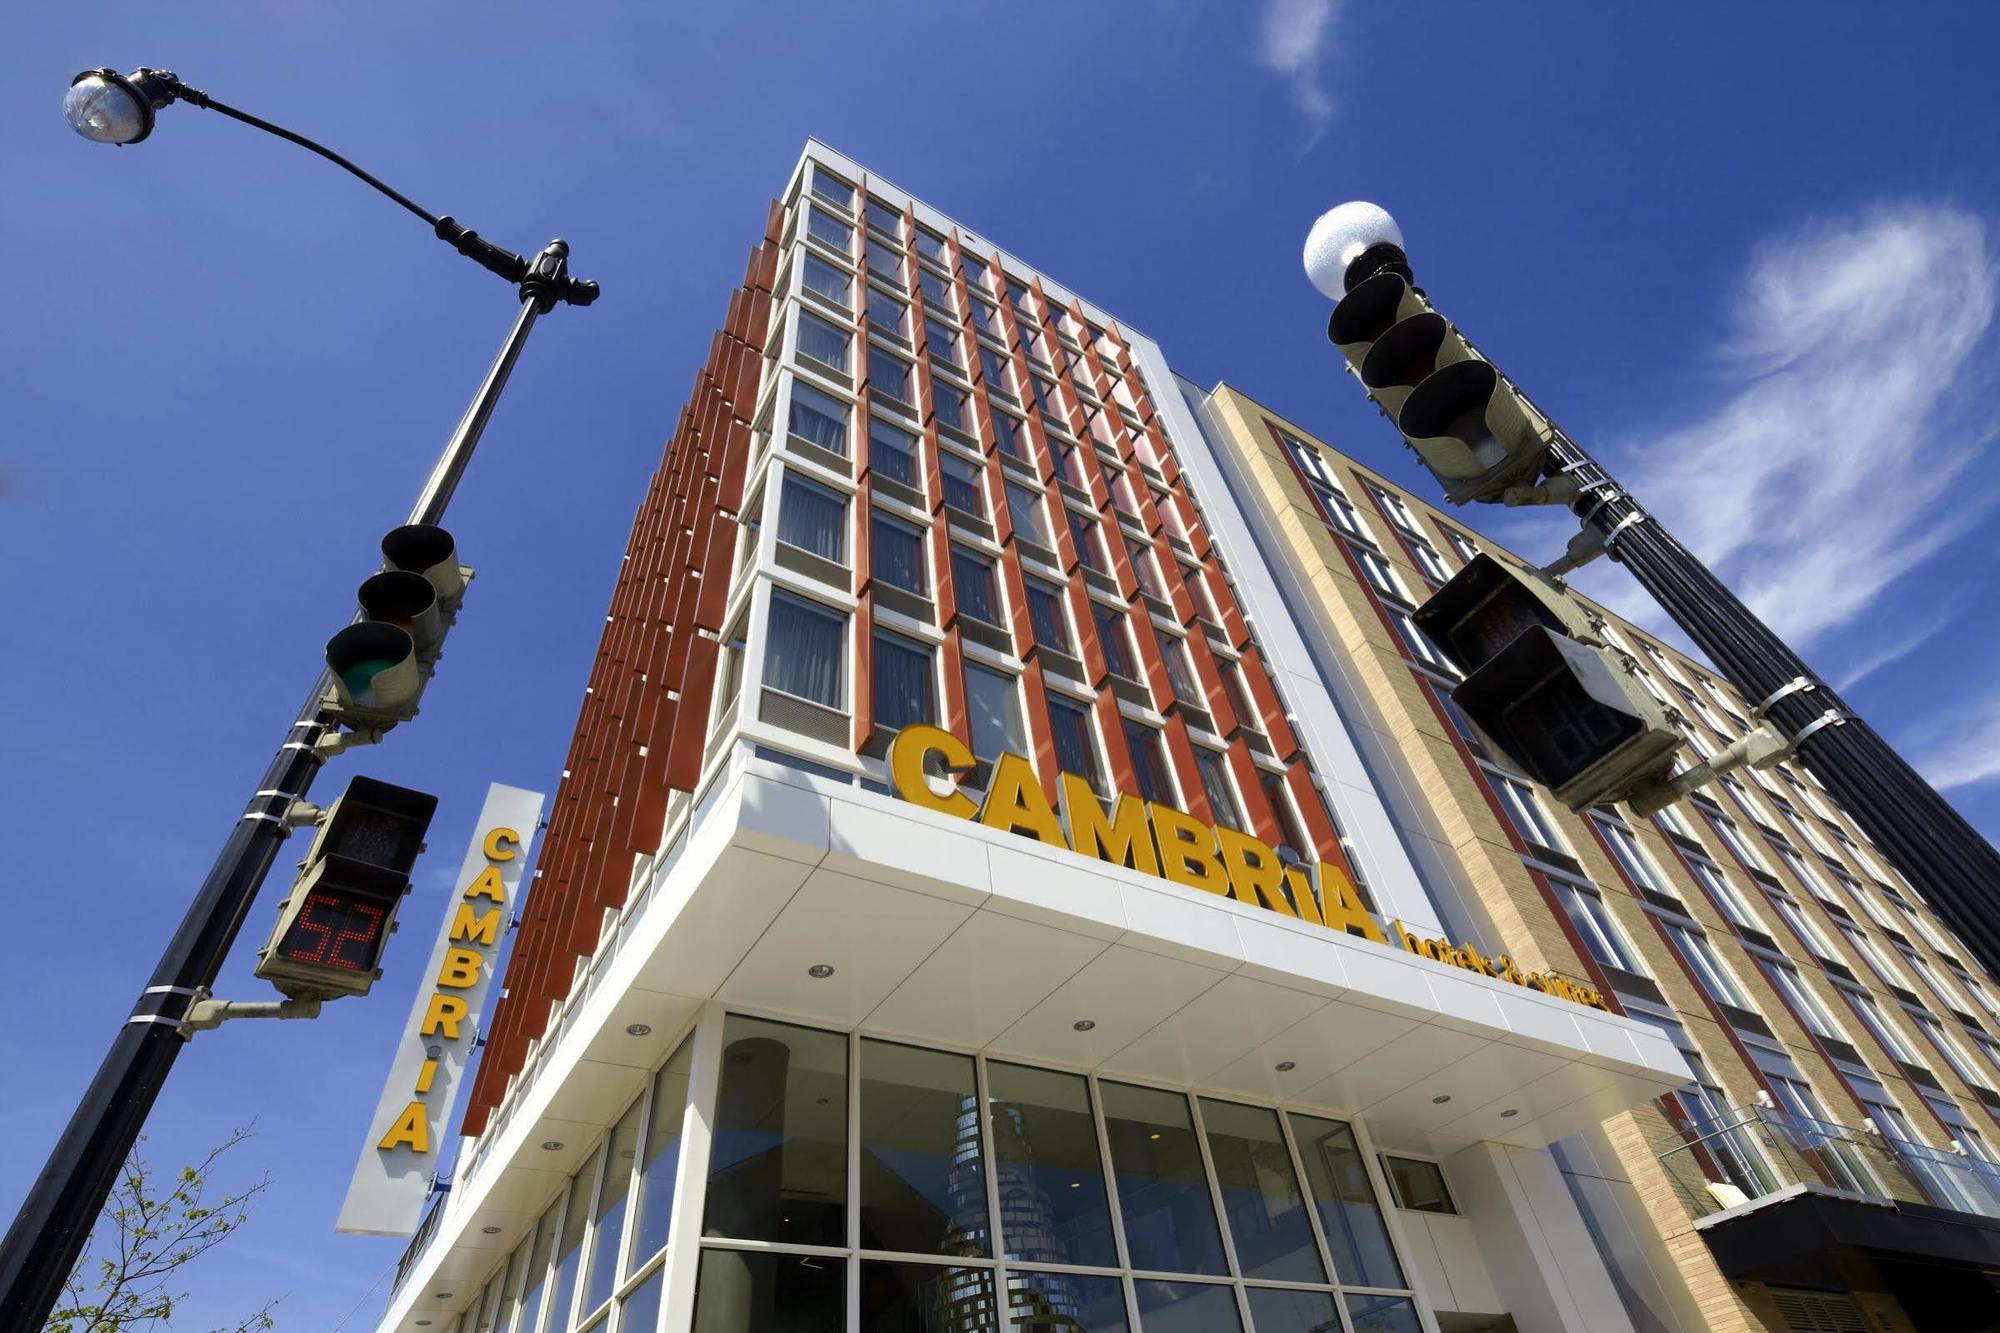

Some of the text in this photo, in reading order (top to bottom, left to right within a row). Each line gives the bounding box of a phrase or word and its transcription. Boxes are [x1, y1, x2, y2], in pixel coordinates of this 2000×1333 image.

[289, 893, 386, 970] 52
[1393, 918, 1498, 979] hotels
[1499, 953, 1527, 986] &
